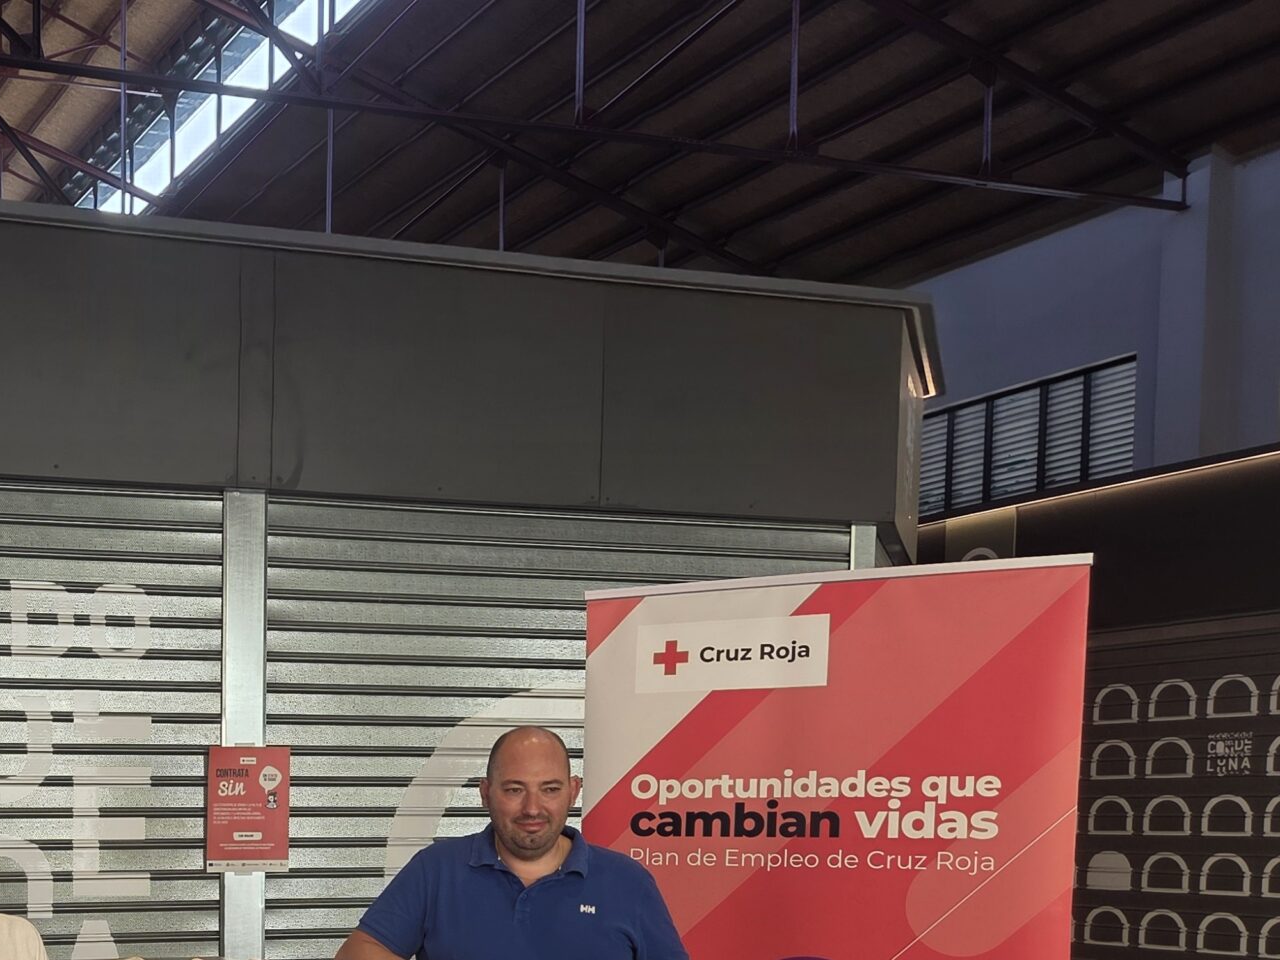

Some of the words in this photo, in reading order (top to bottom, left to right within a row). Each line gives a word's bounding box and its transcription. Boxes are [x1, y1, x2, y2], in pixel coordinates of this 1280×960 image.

[699, 643, 753, 663] Cruz
[759, 641, 811, 663] Roja
[216, 768, 249, 778] CONTRATA
[218, 780, 247, 797] sin
[630, 769, 911, 805] Oportunidades
[921, 774, 1002, 806] que
[629, 800, 841, 839] cambian
[854, 799, 999, 840] vidas
[629, 847, 679, 867] Plan
[687, 848, 717, 867] de
[725, 849, 819, 872] Empleo
[826, 849, 859, 869] de
[866, 851, 928, 870] Cruz
[936, 852, 995, 876] Roja
